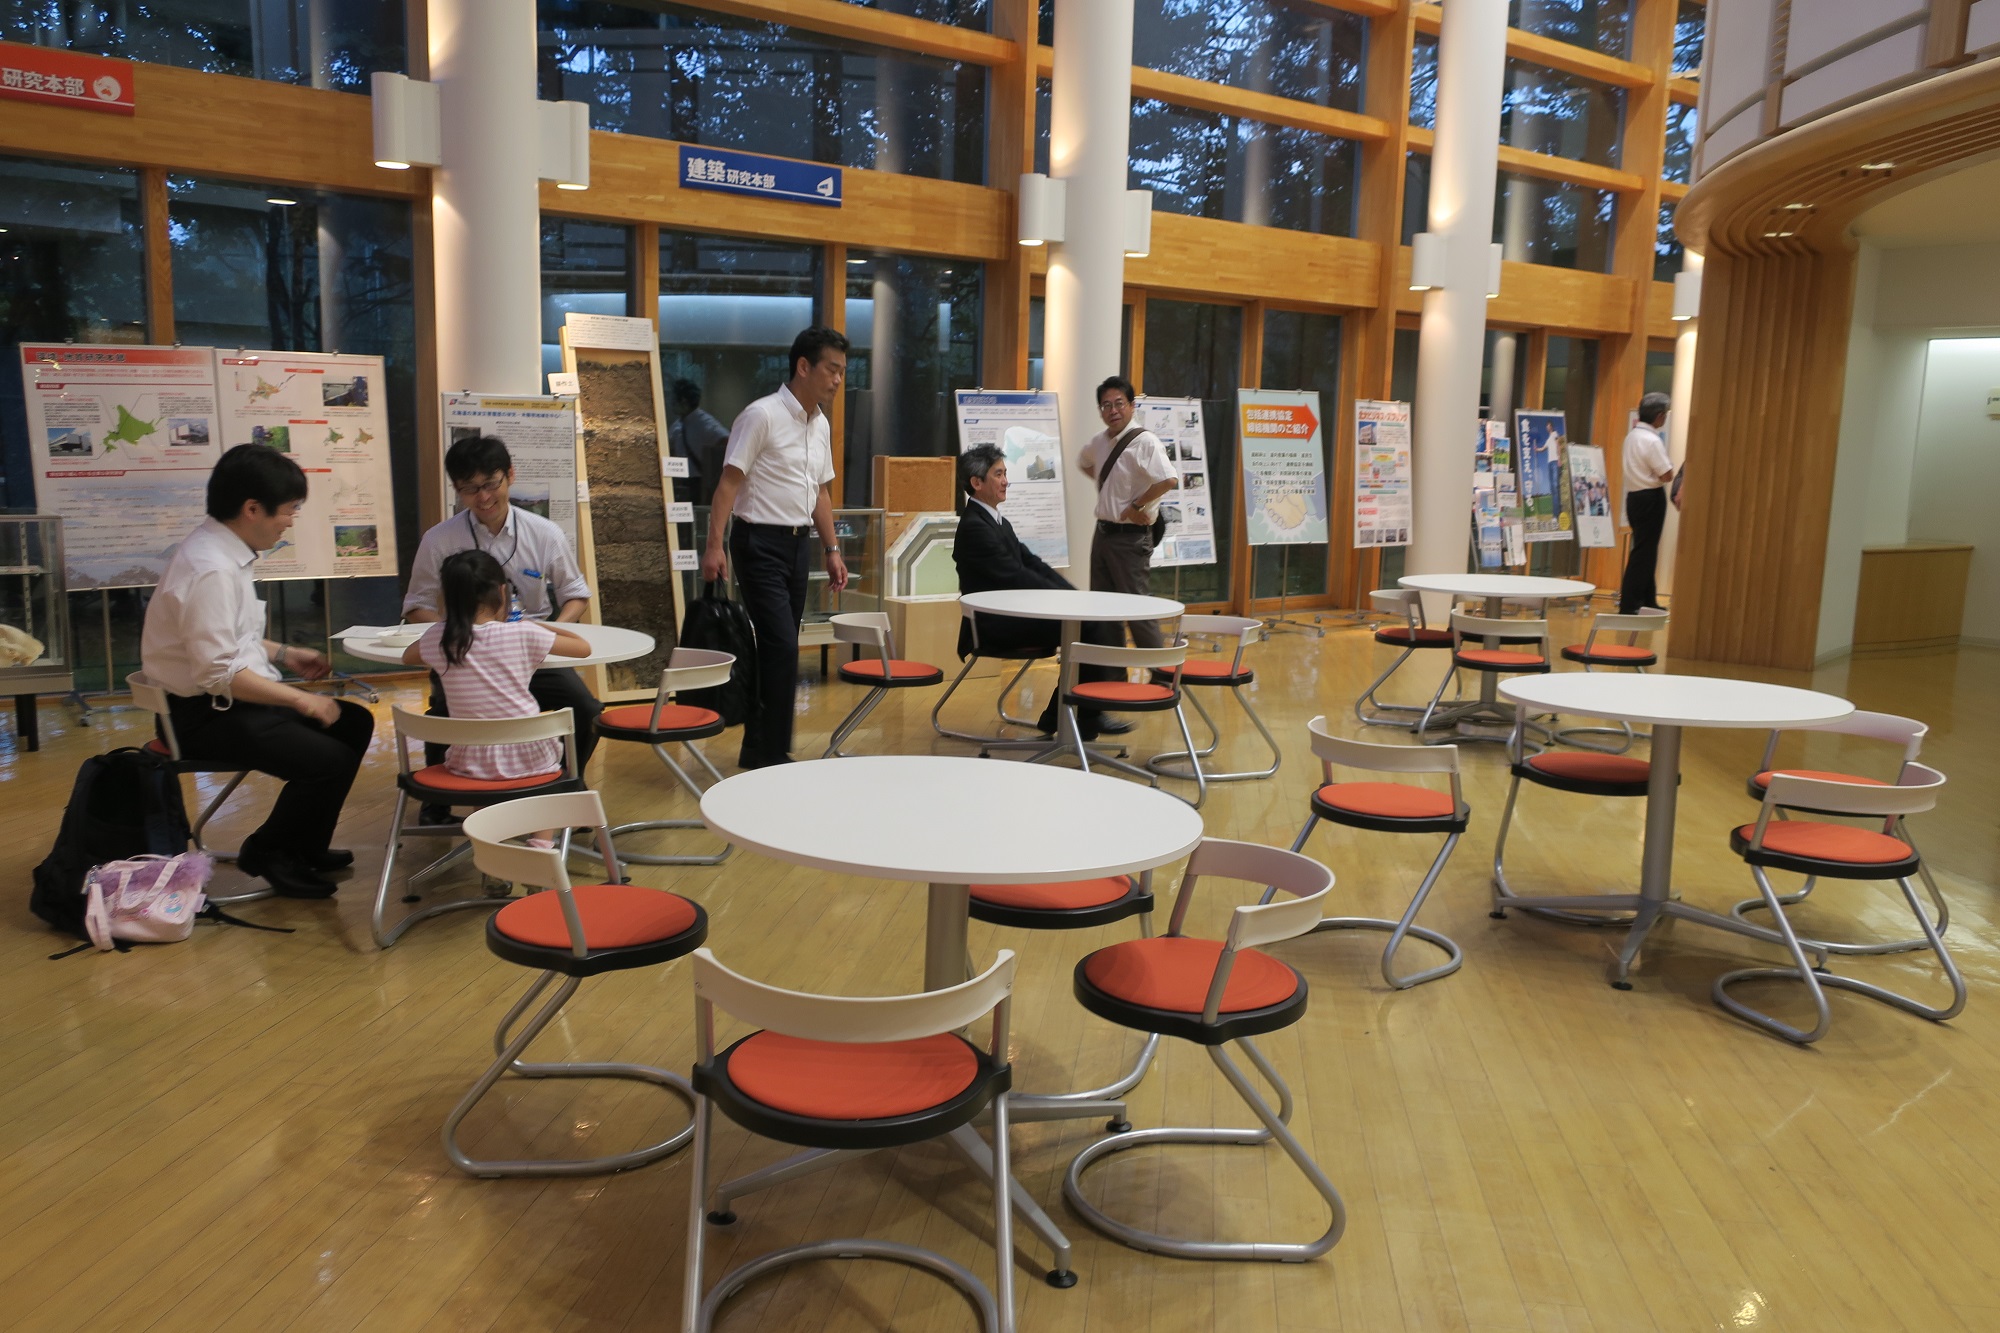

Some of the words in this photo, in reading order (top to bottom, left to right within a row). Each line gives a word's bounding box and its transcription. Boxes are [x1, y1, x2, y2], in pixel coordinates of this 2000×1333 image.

[2, 68, 85, 96] 研究本部
[687, 157, 776, 189] 建築研究本部
[1246, 409, 1293, 421] 包括連携協定
[1247, 423, 1310, 435] 締結機関のご紹介
